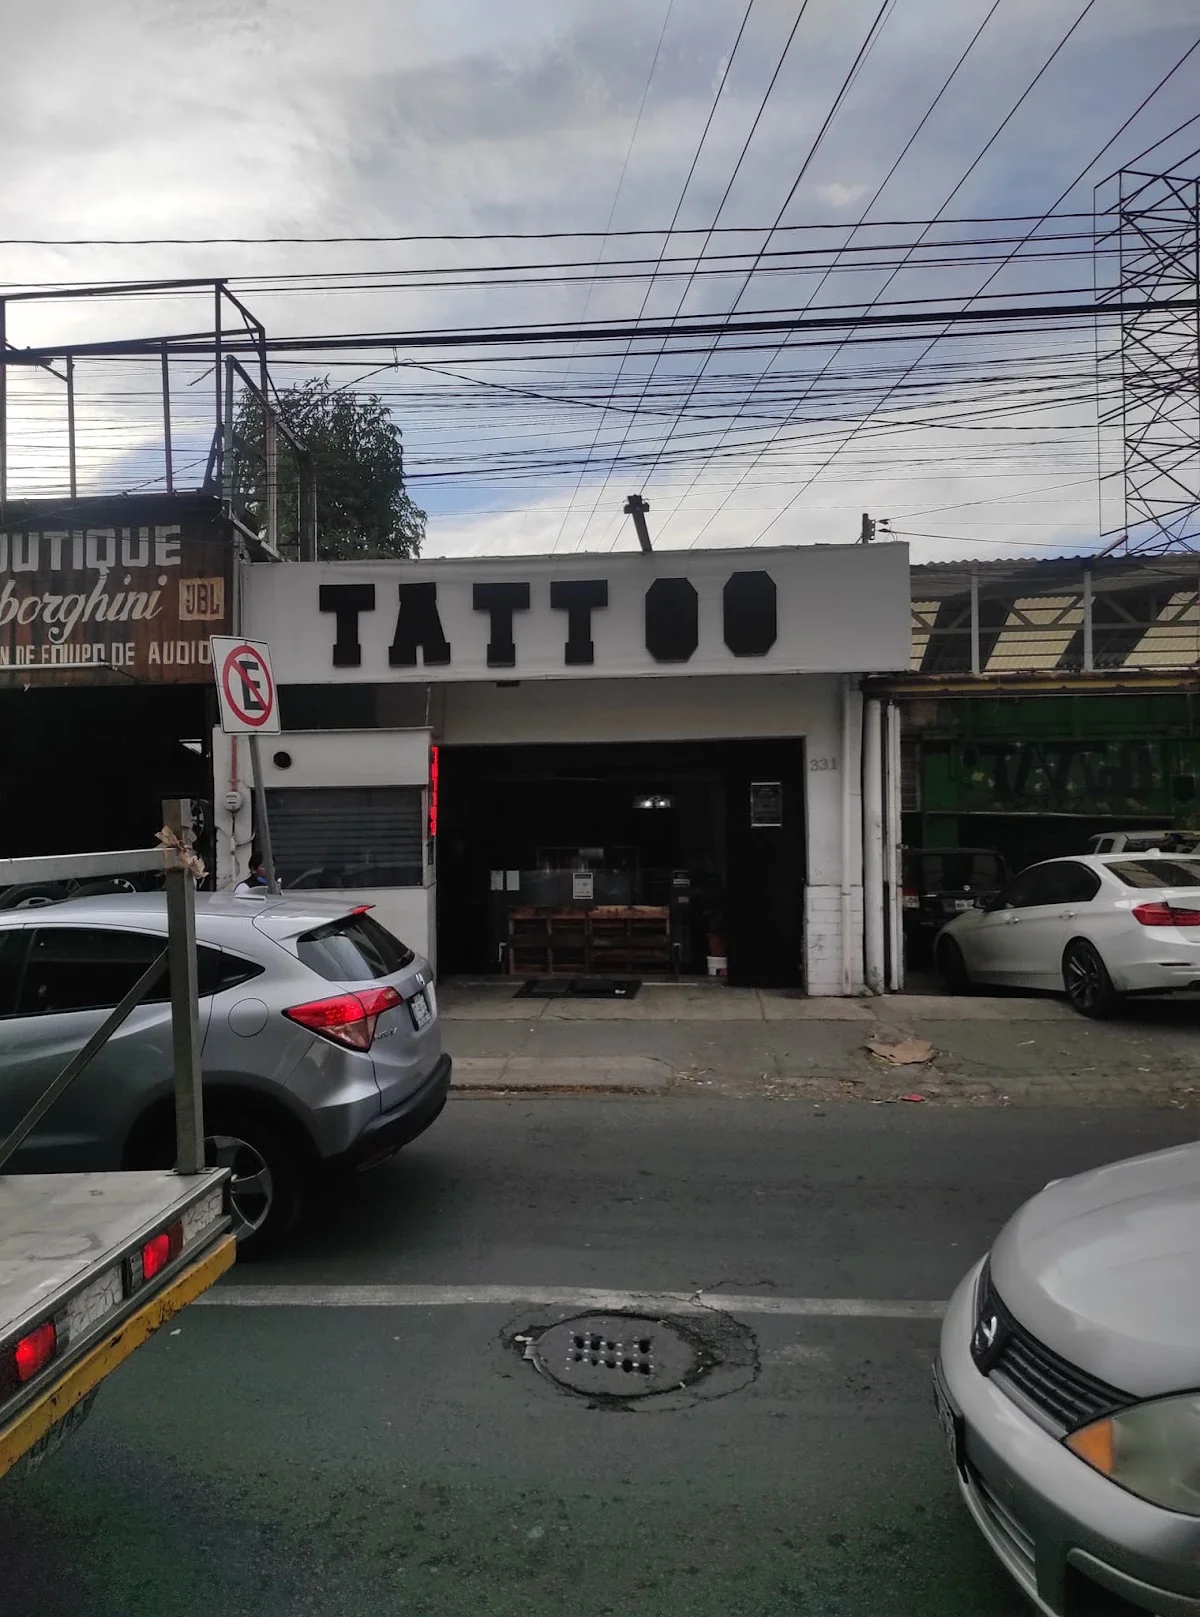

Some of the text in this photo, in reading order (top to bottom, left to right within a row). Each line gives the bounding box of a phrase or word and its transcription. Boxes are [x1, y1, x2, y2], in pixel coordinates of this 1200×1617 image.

[186, 583, 220, 615] JBL
[318, 570, 778, 667] TATTOO
[16, 644, 36, 665] DE
[111, 642, 136, 666] DE
[148, 640, 212, 665] AUDIO
[238, 660, 267, 711] E
[810, 757, 838, 772] 331
